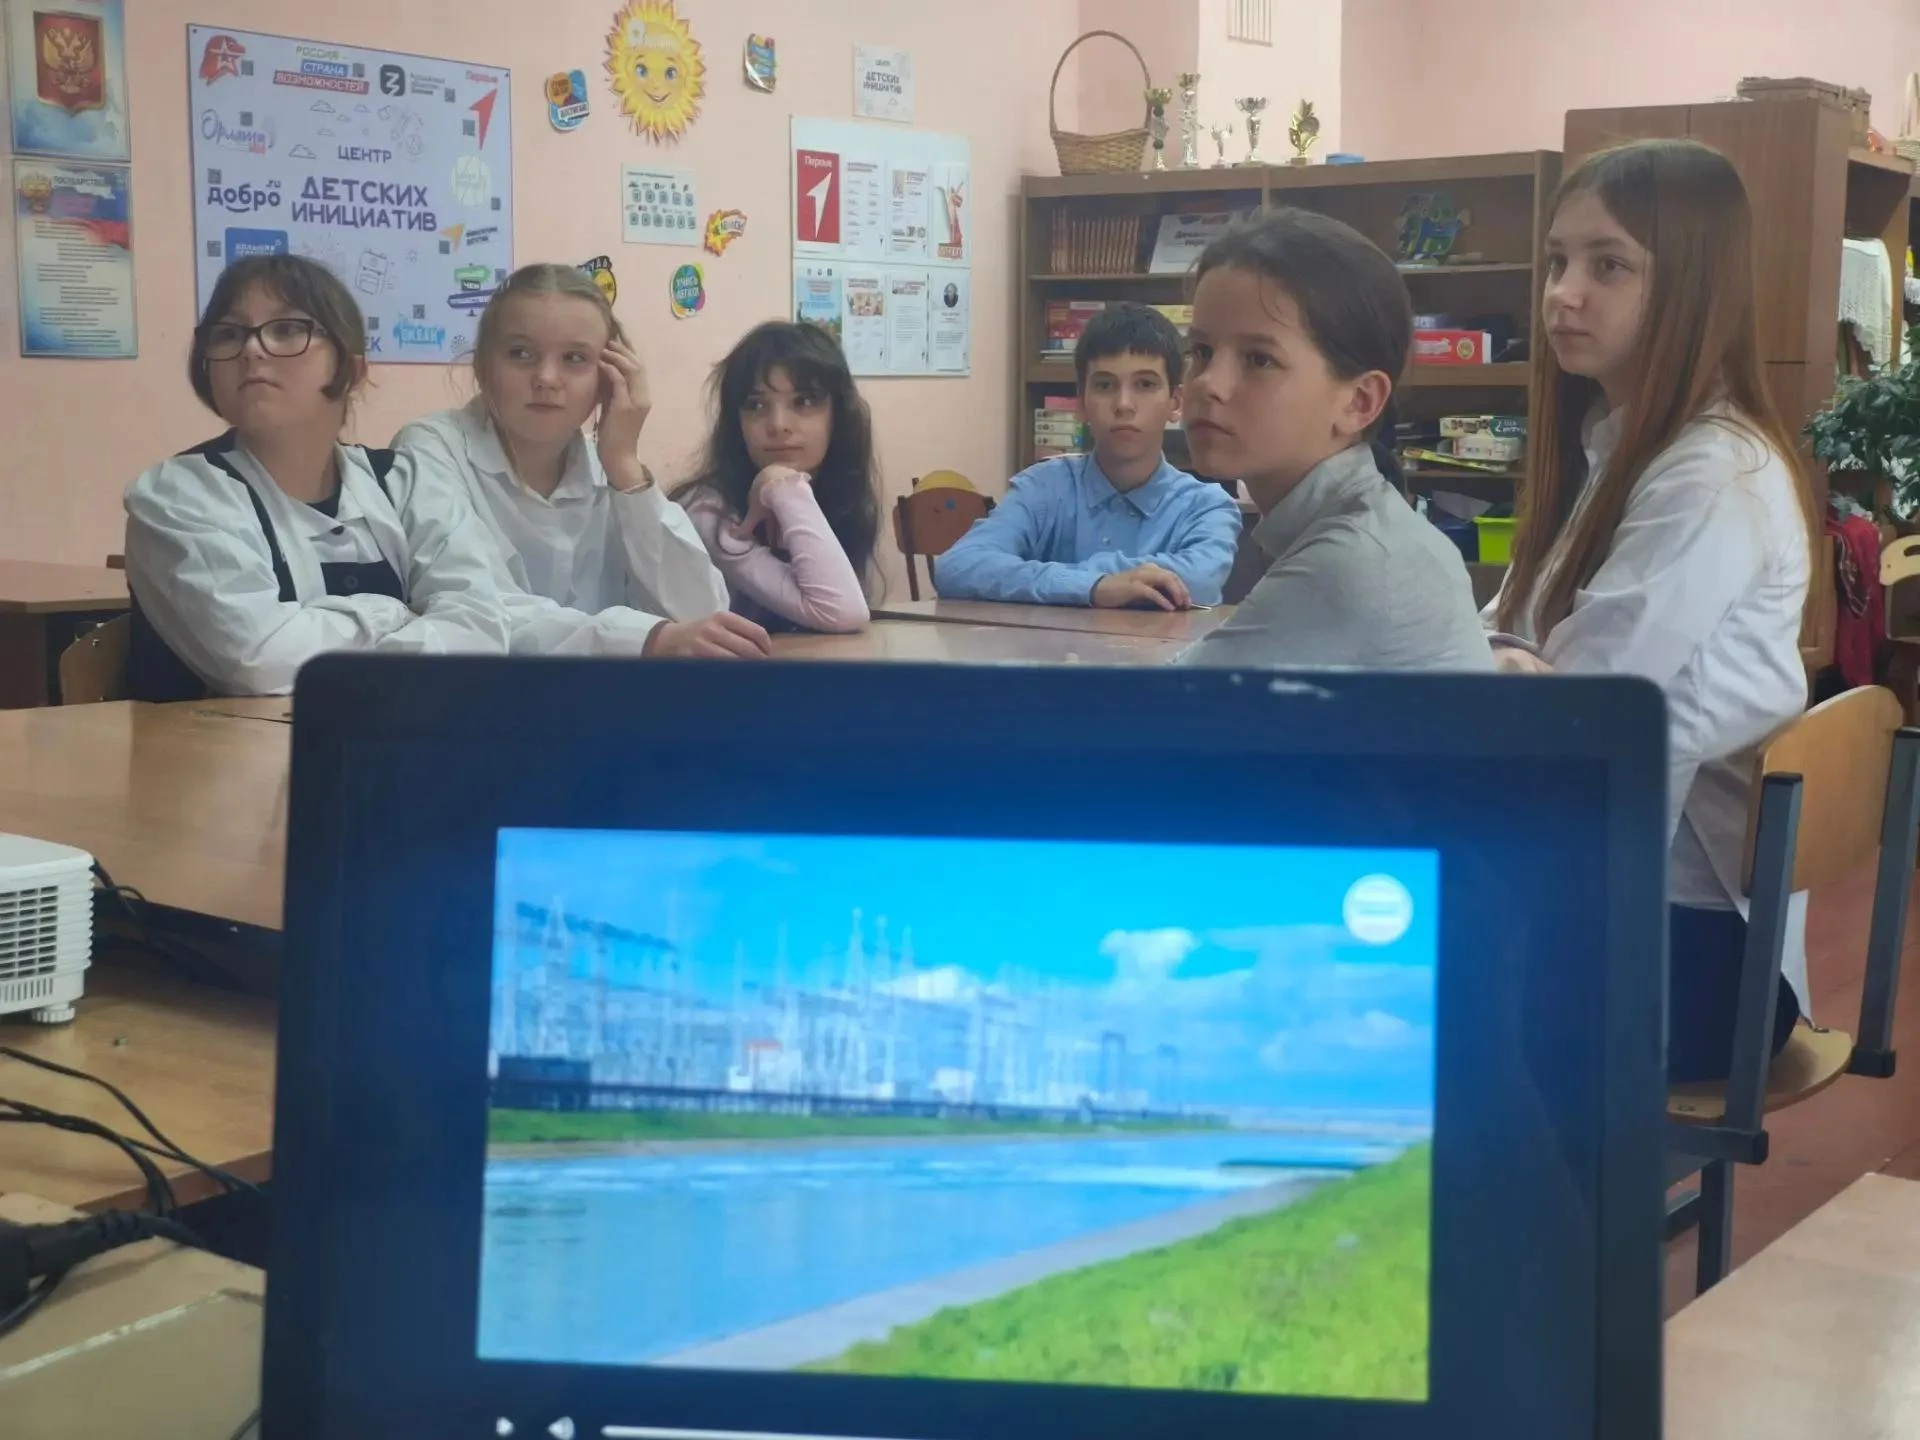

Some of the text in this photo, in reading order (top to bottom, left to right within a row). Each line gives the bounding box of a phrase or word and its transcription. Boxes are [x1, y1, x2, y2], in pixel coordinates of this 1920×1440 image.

[303, 62, 345, 76] СТРАНА
[337, 144, 392, 164] ЦЕНТР
[207, 182, 281, 212] добро
[301, 175, 428, 208] ДЕТСКИХ
[291, 201, 437, 232] ИНИЦИАТИВ
